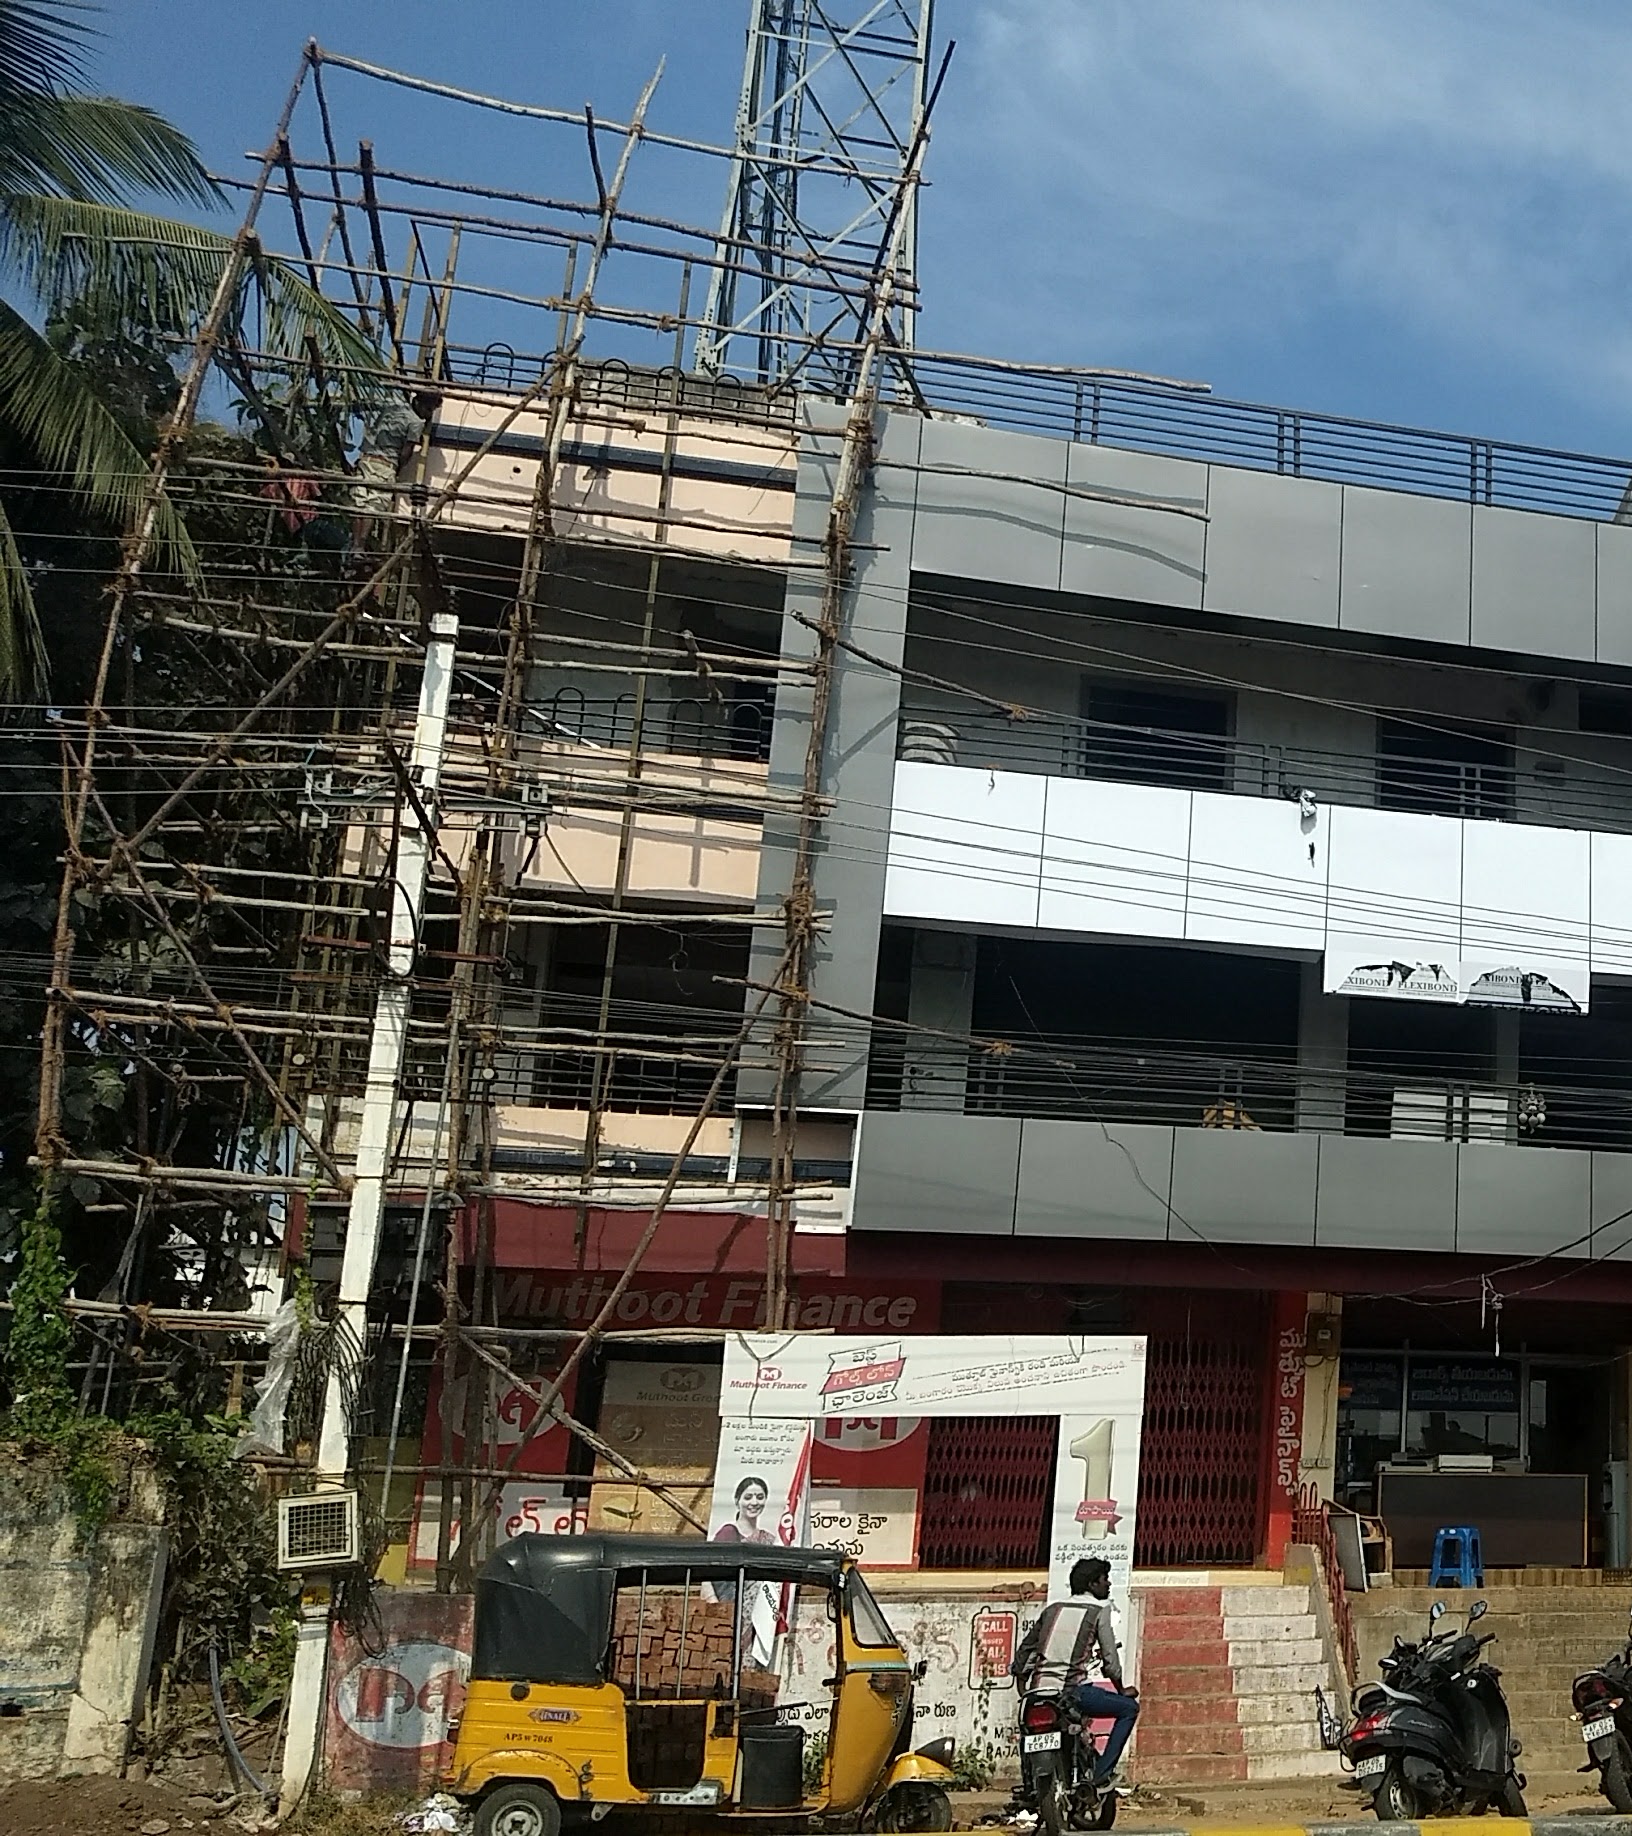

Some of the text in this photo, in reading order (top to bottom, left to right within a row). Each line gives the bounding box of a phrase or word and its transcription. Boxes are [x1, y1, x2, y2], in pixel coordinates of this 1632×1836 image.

[719, 1281, 917, 1327] Fiance
[771, 1382, 808, 1390] Finance
[981, 1620, 1008, 1633] CALL
[1033, 1735, 1043, 1743] AP
